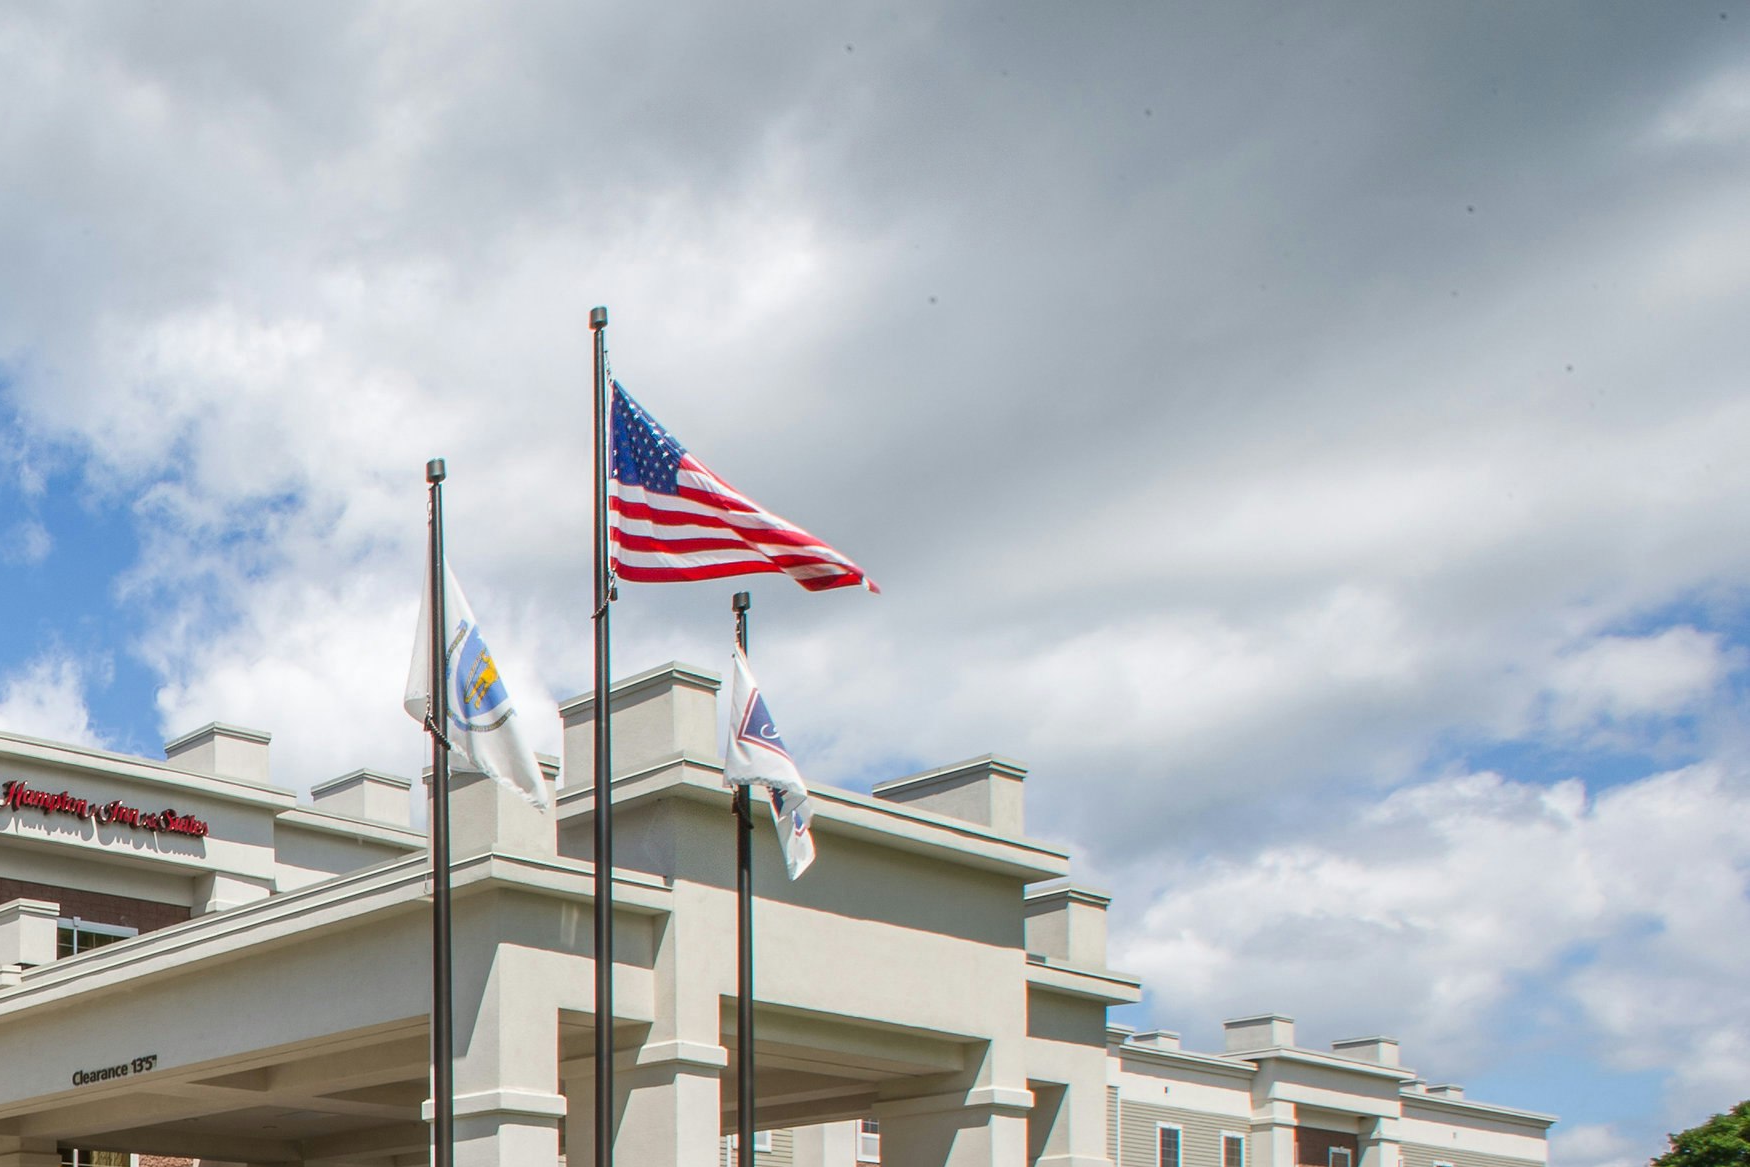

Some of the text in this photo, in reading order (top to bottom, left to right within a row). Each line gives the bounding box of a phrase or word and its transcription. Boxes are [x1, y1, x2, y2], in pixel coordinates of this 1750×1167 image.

[94, 800, 146, 831] Inn
[157, 808, 209, 838] Suites
[72, 1064, 128, 1086] Clearance
